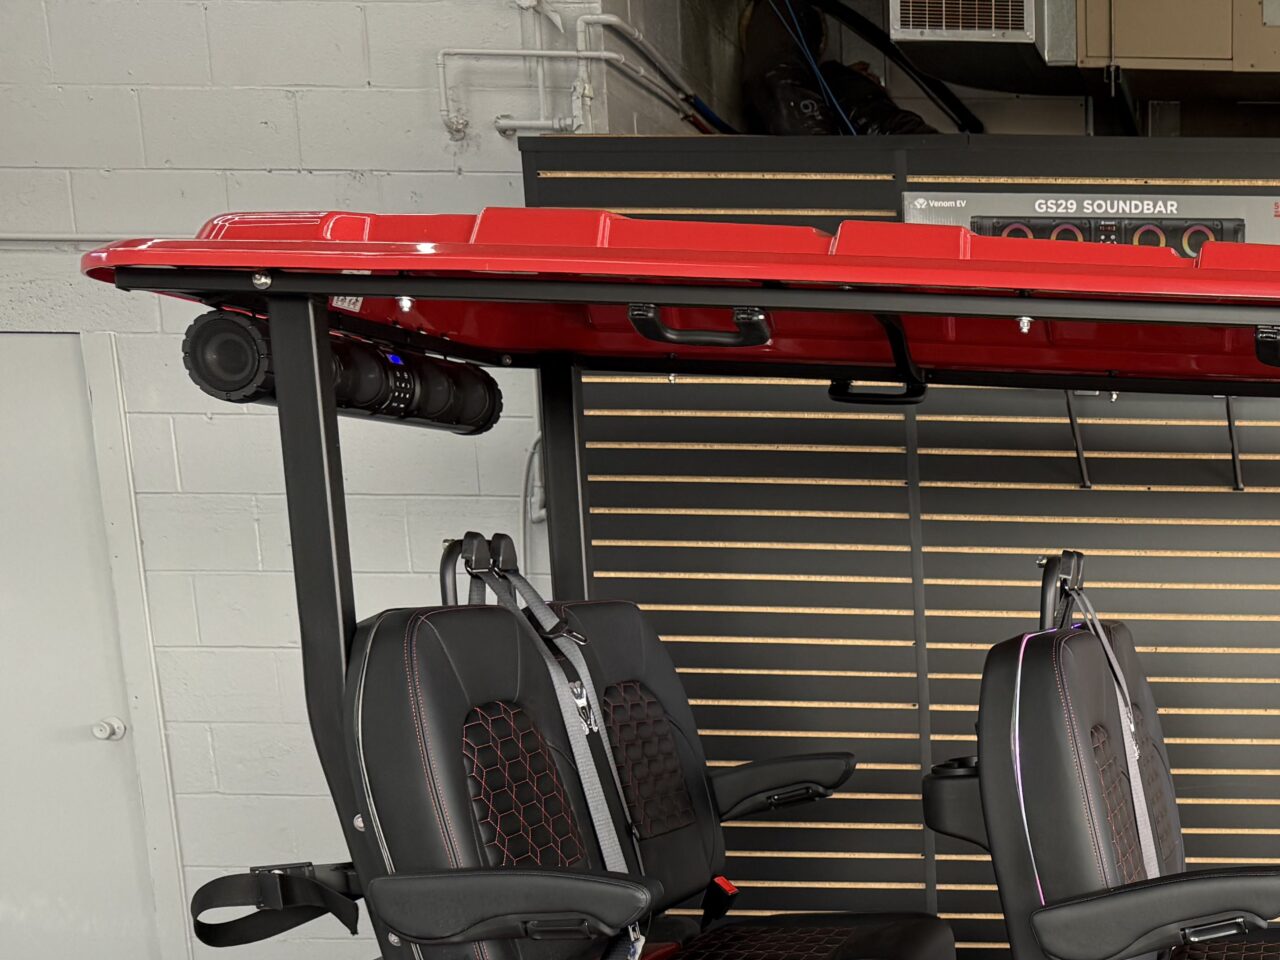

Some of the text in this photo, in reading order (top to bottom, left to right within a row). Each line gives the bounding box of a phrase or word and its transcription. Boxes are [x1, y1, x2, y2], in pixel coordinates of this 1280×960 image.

[928, 200, 967, 208] Venom EV
[1034, 199, 1178, 214] GS29 SOUNDBAR
